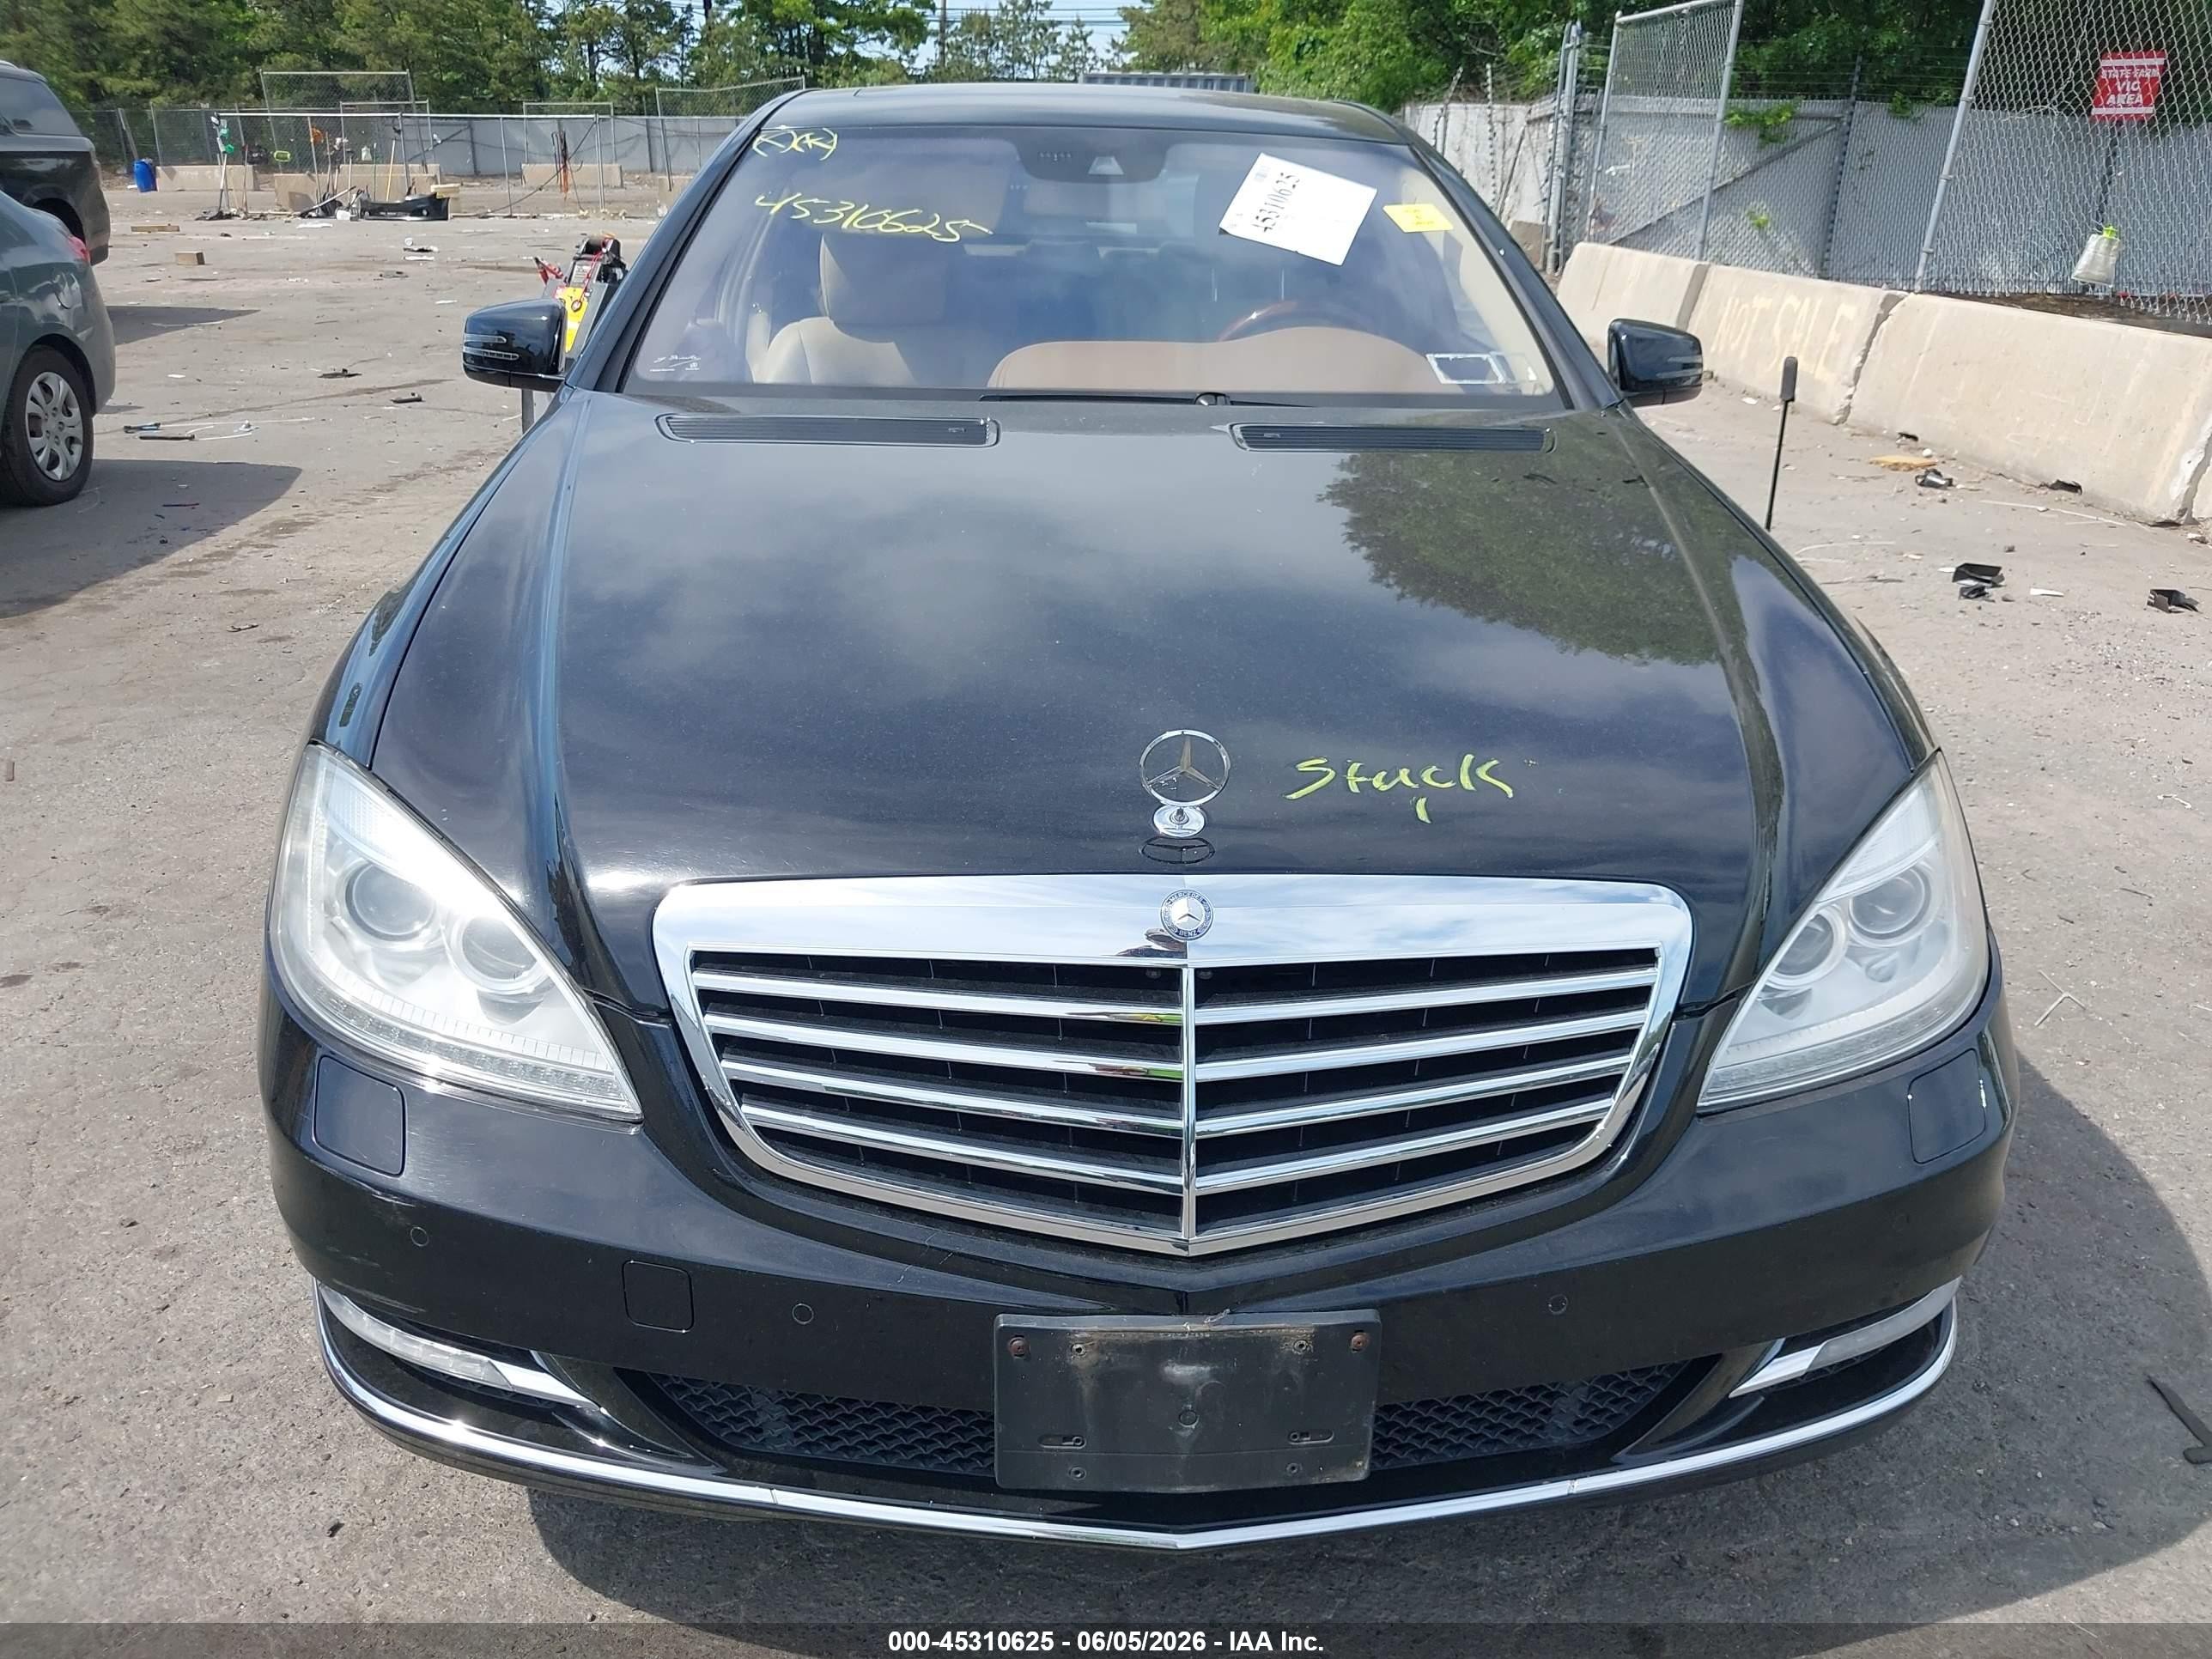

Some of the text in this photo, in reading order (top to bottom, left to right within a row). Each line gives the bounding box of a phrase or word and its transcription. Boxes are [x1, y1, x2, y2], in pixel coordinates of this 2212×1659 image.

[2100, 68, 2160, 78] STATE FARM
[2106, 94, 2143, 105] AREA
[755, 192, 994, 242] 45310625
[1251, 172, 1301, 233] 45310625
